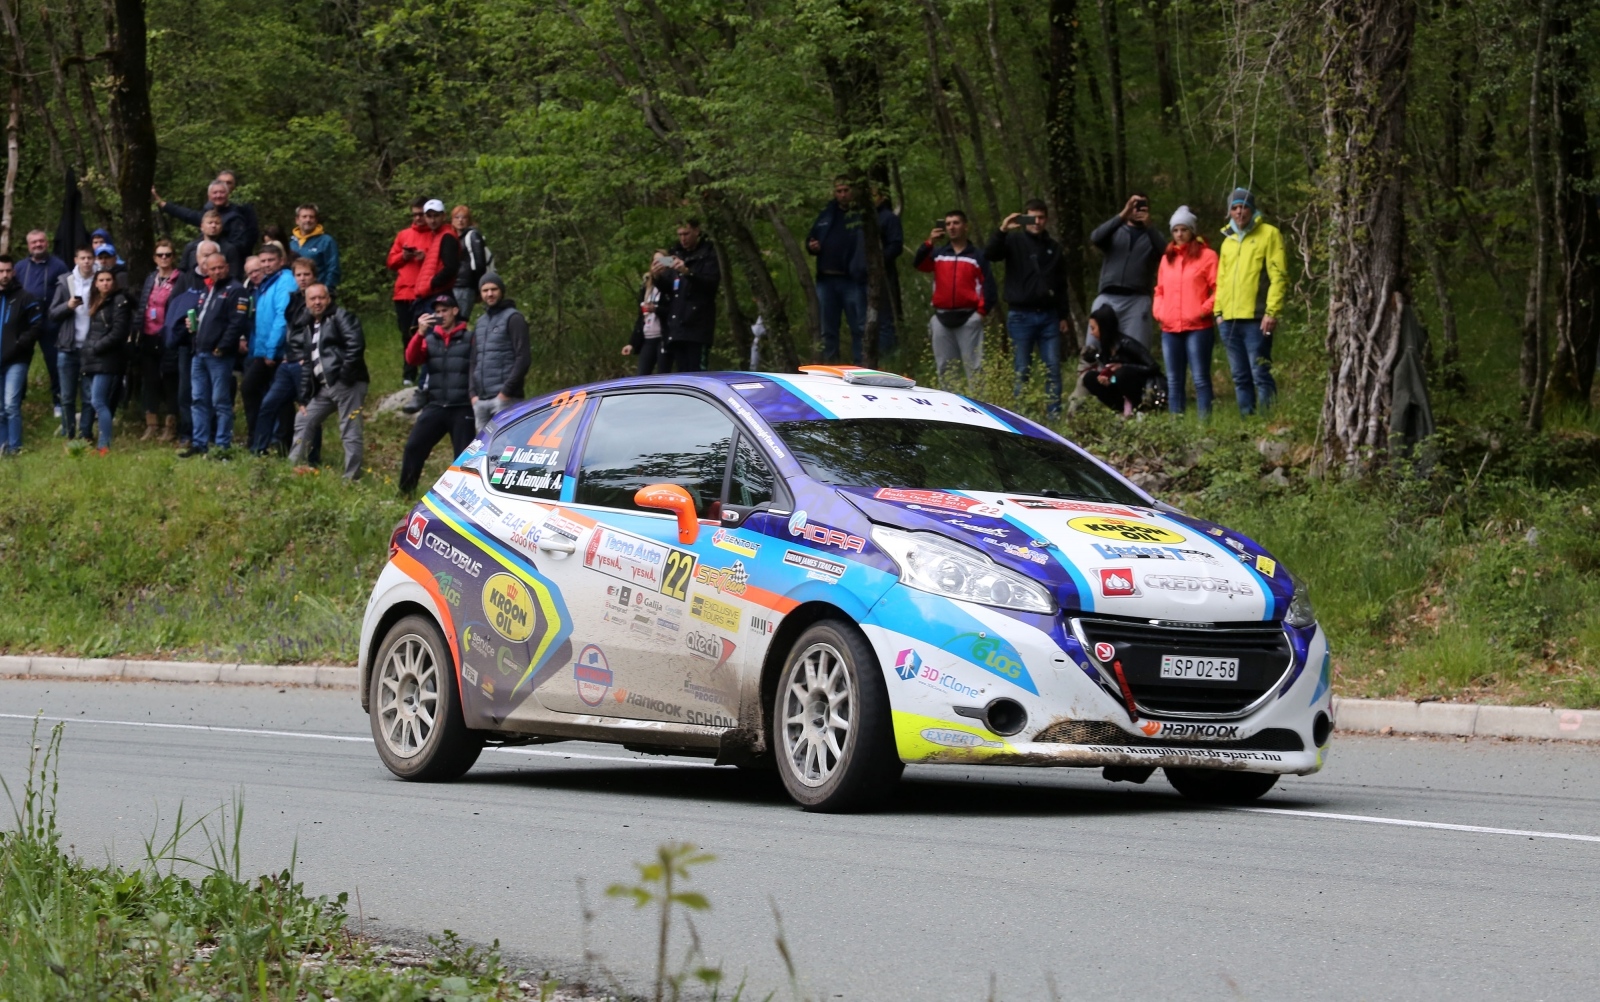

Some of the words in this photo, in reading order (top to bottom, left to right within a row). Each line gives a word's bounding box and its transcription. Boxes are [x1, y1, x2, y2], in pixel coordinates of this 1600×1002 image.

[527, 390, 587, 448] 22
[512, 448, 550, 464] Kulcsár
[547, 451, 560, 466] D.
[502, 469, 516, 489] ifj.
[516, 471, 552, 491] Kanyik
[550, 473, 563, 490] A.
[977, 505, 1000, 515] 22
[793, 522, 866, 554] HIDRA
[1083, 523, 1171, 537] KROON
[1121, 531, 1161, 542] OIL
[510, 531, 527, 548] 2000
[528, 540, 538, 554] Kft
[424, 532, 483, 578] CREDOBUS
[633, 543, 661, 565] Auto
[800, 556, 818, 567] JAMES
[660, 551, 693, 600] 22
[1143, 573, 1254, 597] CREDOBUS
[490, 588, 528, 627] KROON
[703, 600, 740, 620] EXCLUSIVE
[703, 610, 724, 625] TOURS
[496, 611, 512, 636] OIL
[971, 641, 1022, 679] 6LOG
[1174, 661, 1193, 677] SP
[1199, 661, 1236, 679] 02-58
[920, 665, 939, 681] 3D
[939, 673, 979, 699] iClone
[926, 730, 978, 745] EXPERT
